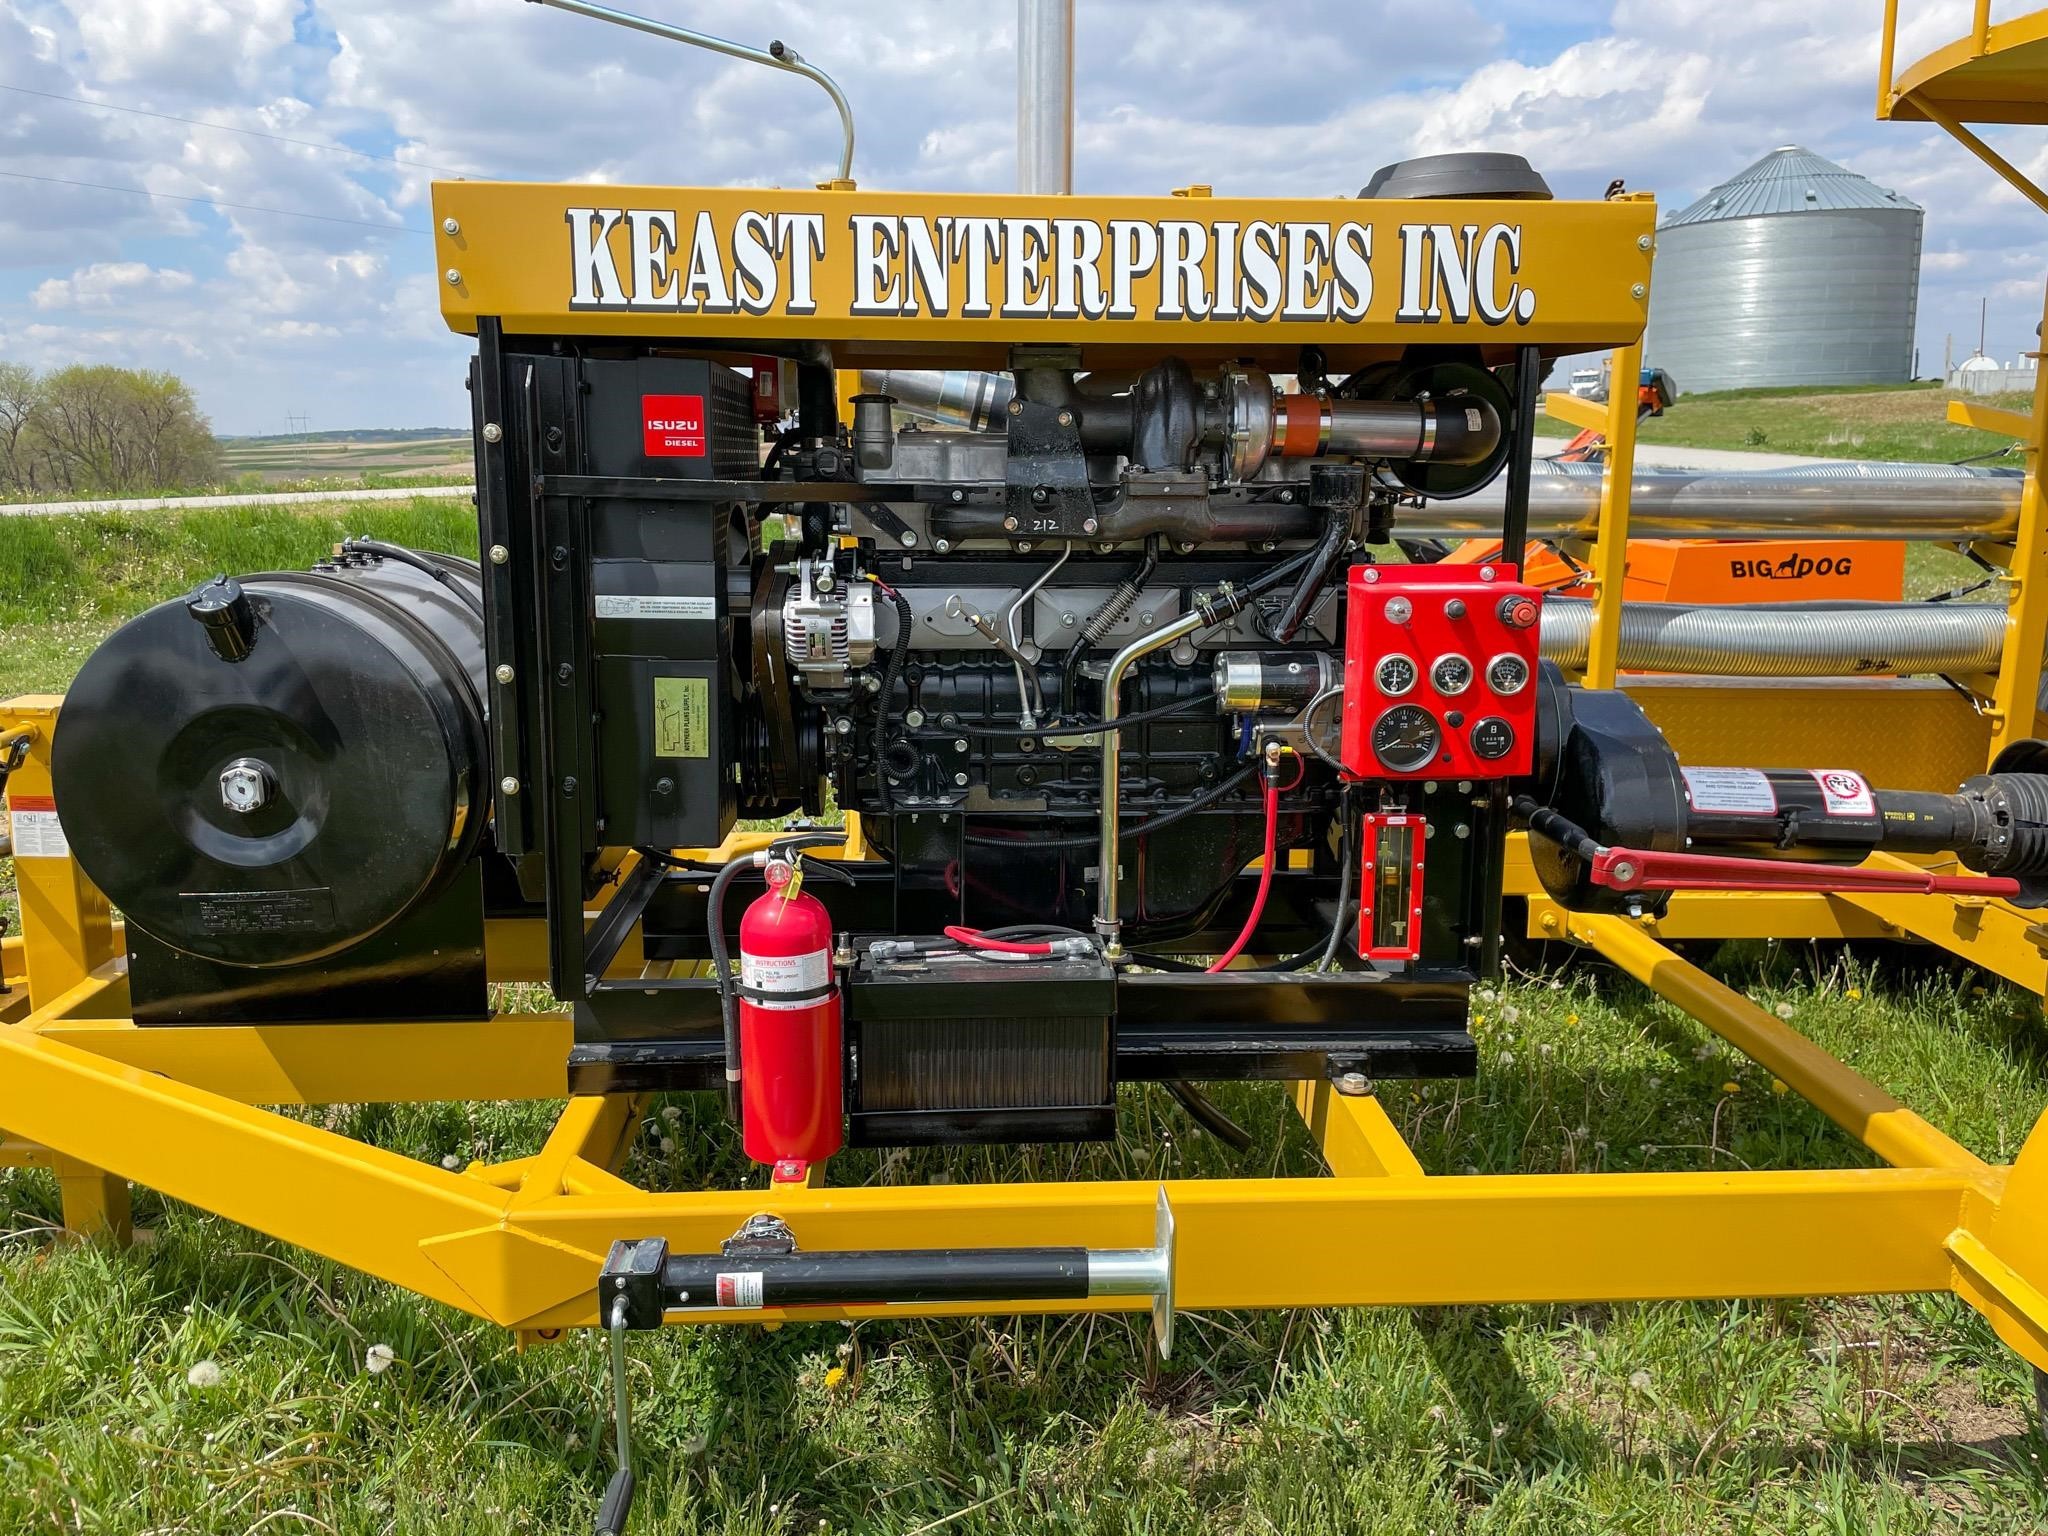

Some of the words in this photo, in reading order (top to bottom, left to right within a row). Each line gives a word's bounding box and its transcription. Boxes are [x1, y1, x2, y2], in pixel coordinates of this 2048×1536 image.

[566, 207, 826, 315] KEAST
[850, 214, 1373, 320] ENTERPRISES
[1397, 223, 1536, 322] INC.
[647, 420, 698, 431] ISUZU
[665, 439, 698, 447] DIESEL
[1033, 519, 1059, 532] 212
[1730, 559, 1772, 578] BIG
[1797, 557, 1852, 578] DOG
[755, 959, 796, 967] INSTRUCTIONS
